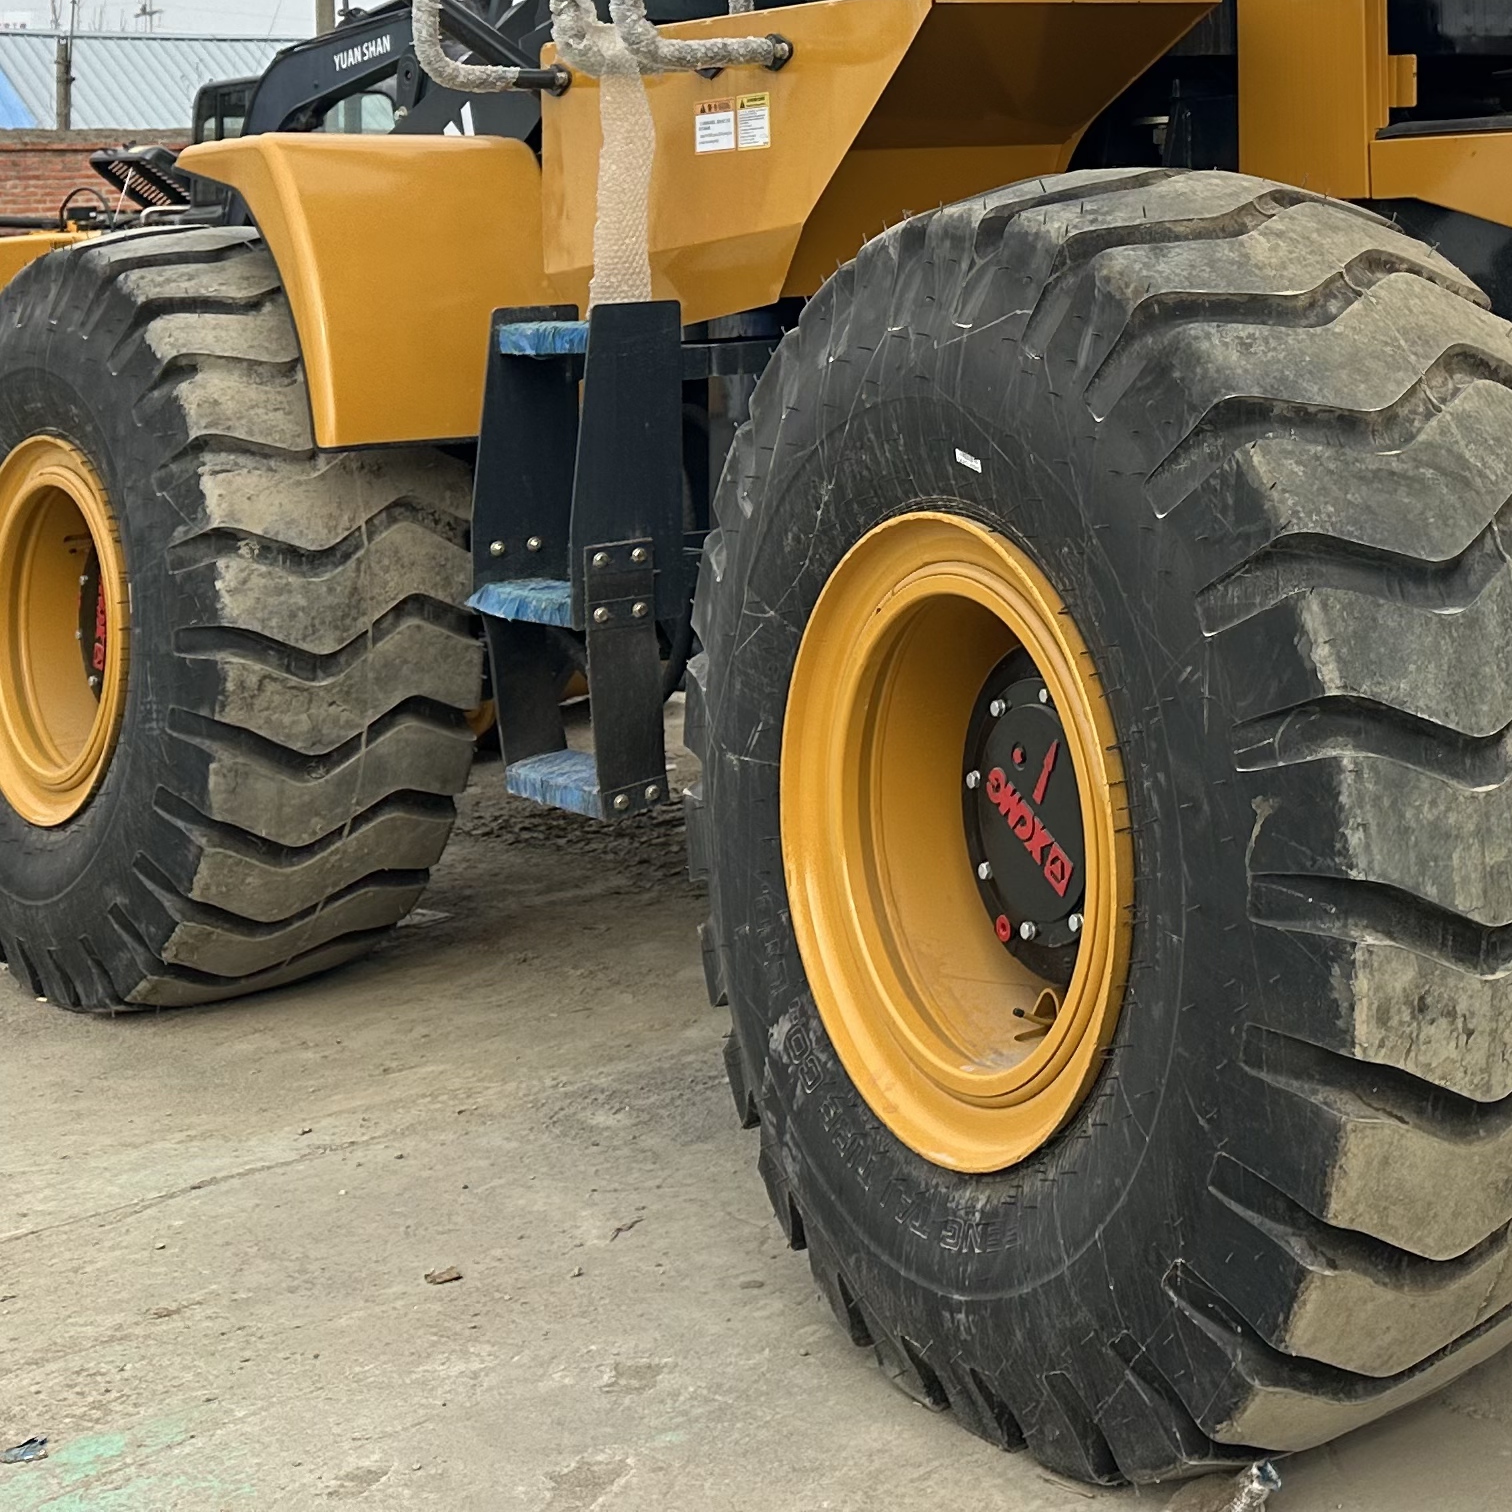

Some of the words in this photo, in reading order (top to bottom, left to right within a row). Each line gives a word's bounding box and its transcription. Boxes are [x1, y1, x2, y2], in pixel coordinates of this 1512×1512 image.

[333, 45, 362, 72] YUAN
[362, 34, 391, 61] SHAN
[986, 767, 1055, 866] XCMG
